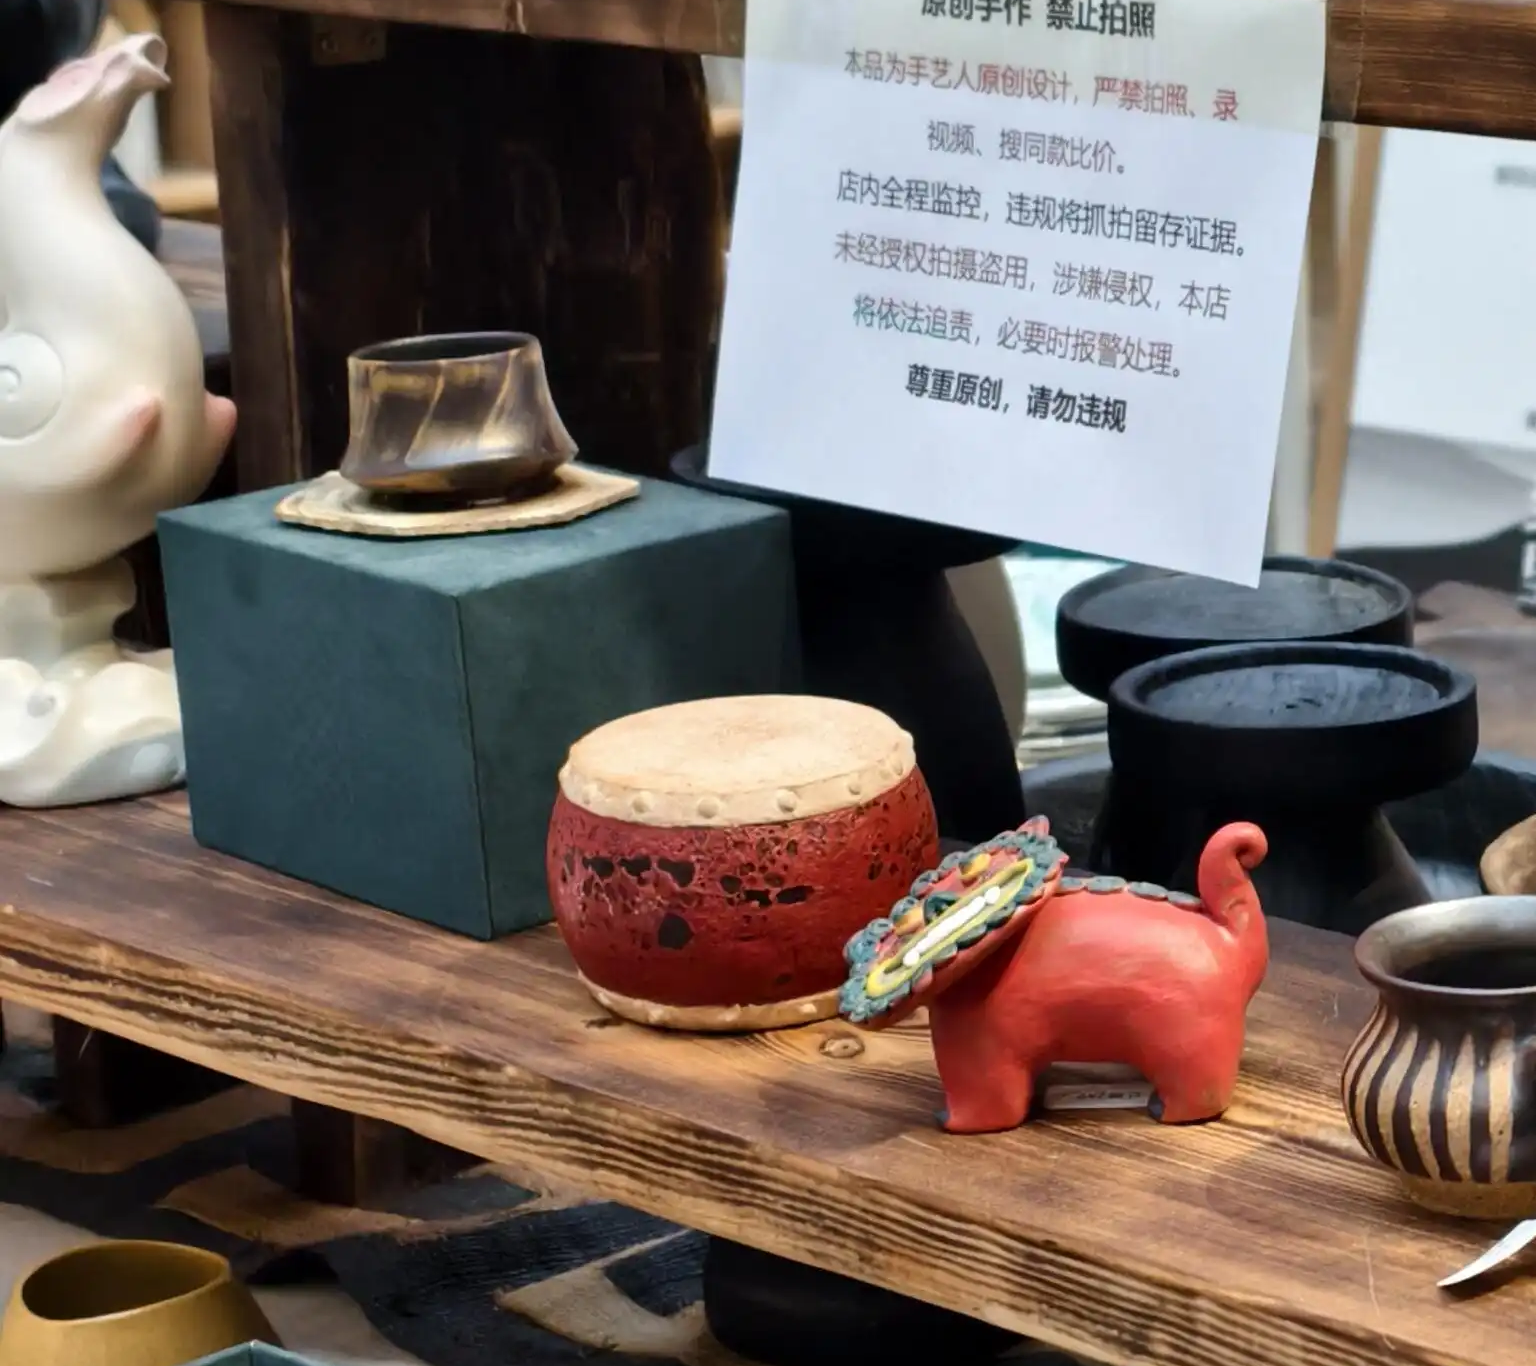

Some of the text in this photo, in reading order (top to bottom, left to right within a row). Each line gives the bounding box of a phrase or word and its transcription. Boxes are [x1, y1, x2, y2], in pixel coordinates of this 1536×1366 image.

[843, 47, 1240, 123] 本品为手艺人原创设计，严禁拍照、录
[926, 119, 1125, 175] 视频、搜同款比价。
[836, 168, 1246, 258] 店内全程监控，违规将抓拍留存证据。
[834, 230, 1233, 322] 未经授权拍摄盗用，涉嫌侵权，本店
[852, 294, 1182, 380] 将依法追责，必要时报警处理。
[904, 362, 1129, 435] 尊重原创，请勿违规
